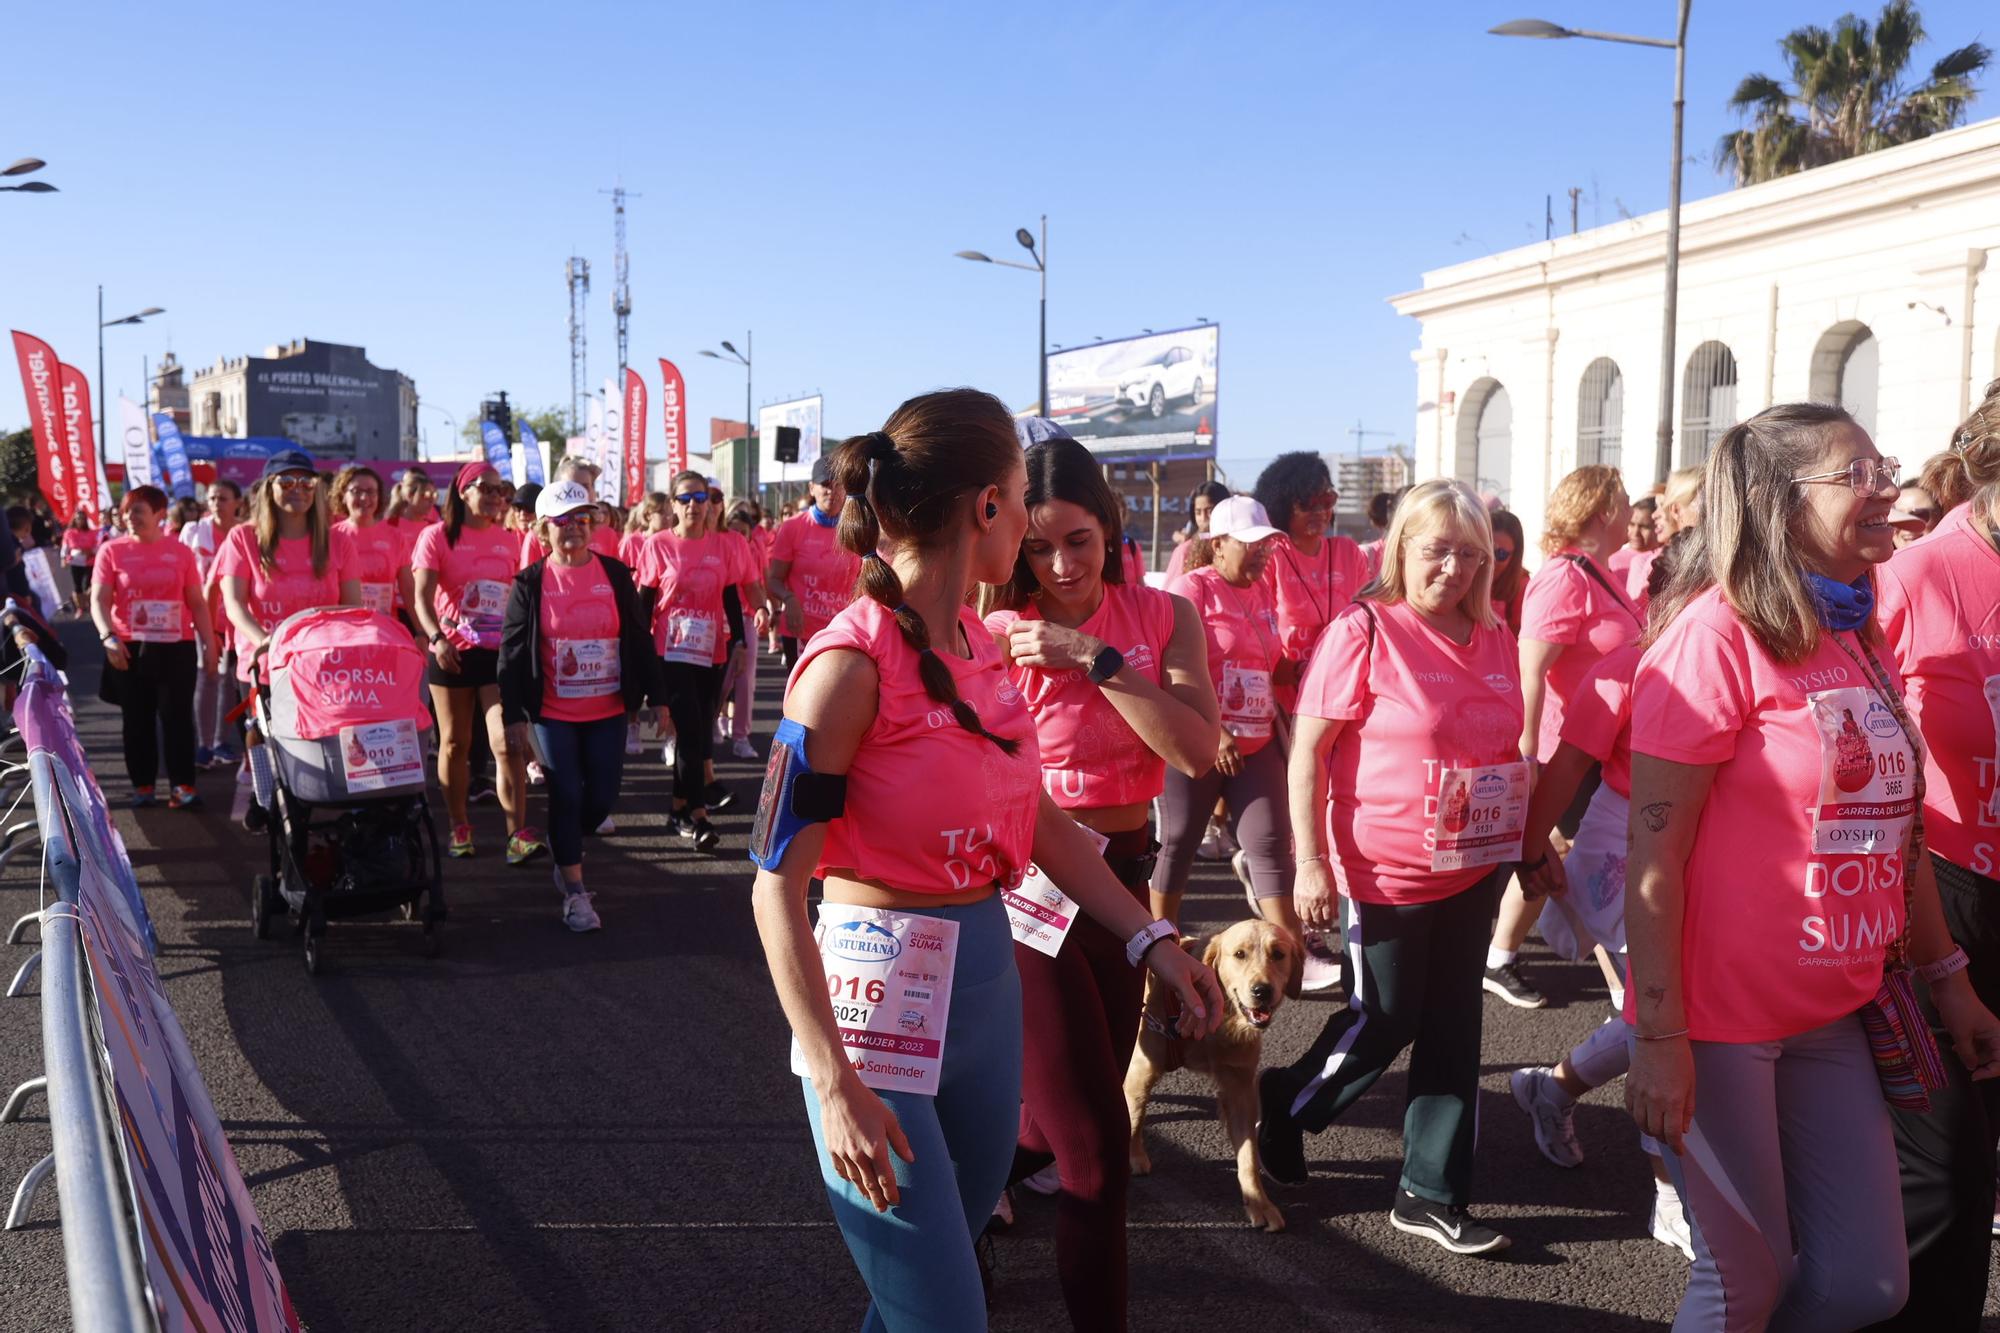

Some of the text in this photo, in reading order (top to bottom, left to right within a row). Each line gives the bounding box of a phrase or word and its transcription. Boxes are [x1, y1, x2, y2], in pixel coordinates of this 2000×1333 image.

[271, 372, 312, 385] PUERTO
[261, 602, 281, 615] TU
[320, 668, 396, 685] DORSAL
[320, 688, 381, 705] SUMA
[369, 746, 394, 760] 016
[1878, 751, 1906, 776] 016
[1885, 780, 1903, 796] 3665
[1471, 806, 1501, 822] 016
[1837, 807, 1885, 816] CARRERA
[1474, 824, 1493, 834] 5131
[1830, 829, 1885, 842] OYSHO
[940, 823, 993, 856] TU
[1009, 897, 1037, 913] MUJER
[1038, 910, 1058, 923] 2023
[1010, 916, 1053, 942] Santander
[1799, 904, 1897, 952] SUMA
[829, 932, 895, 956] ASTURIANA
[909, 939, 943, 952] SUMA
[920, 933, 945, 942] DORSAL
[827, 974, 886, 1004] 016
[833, 1005, 867, 1023] 6021
[842, 1032, 924, 1052] LA MUJER 2023
[866, 1060, 926, 1079] Santander
